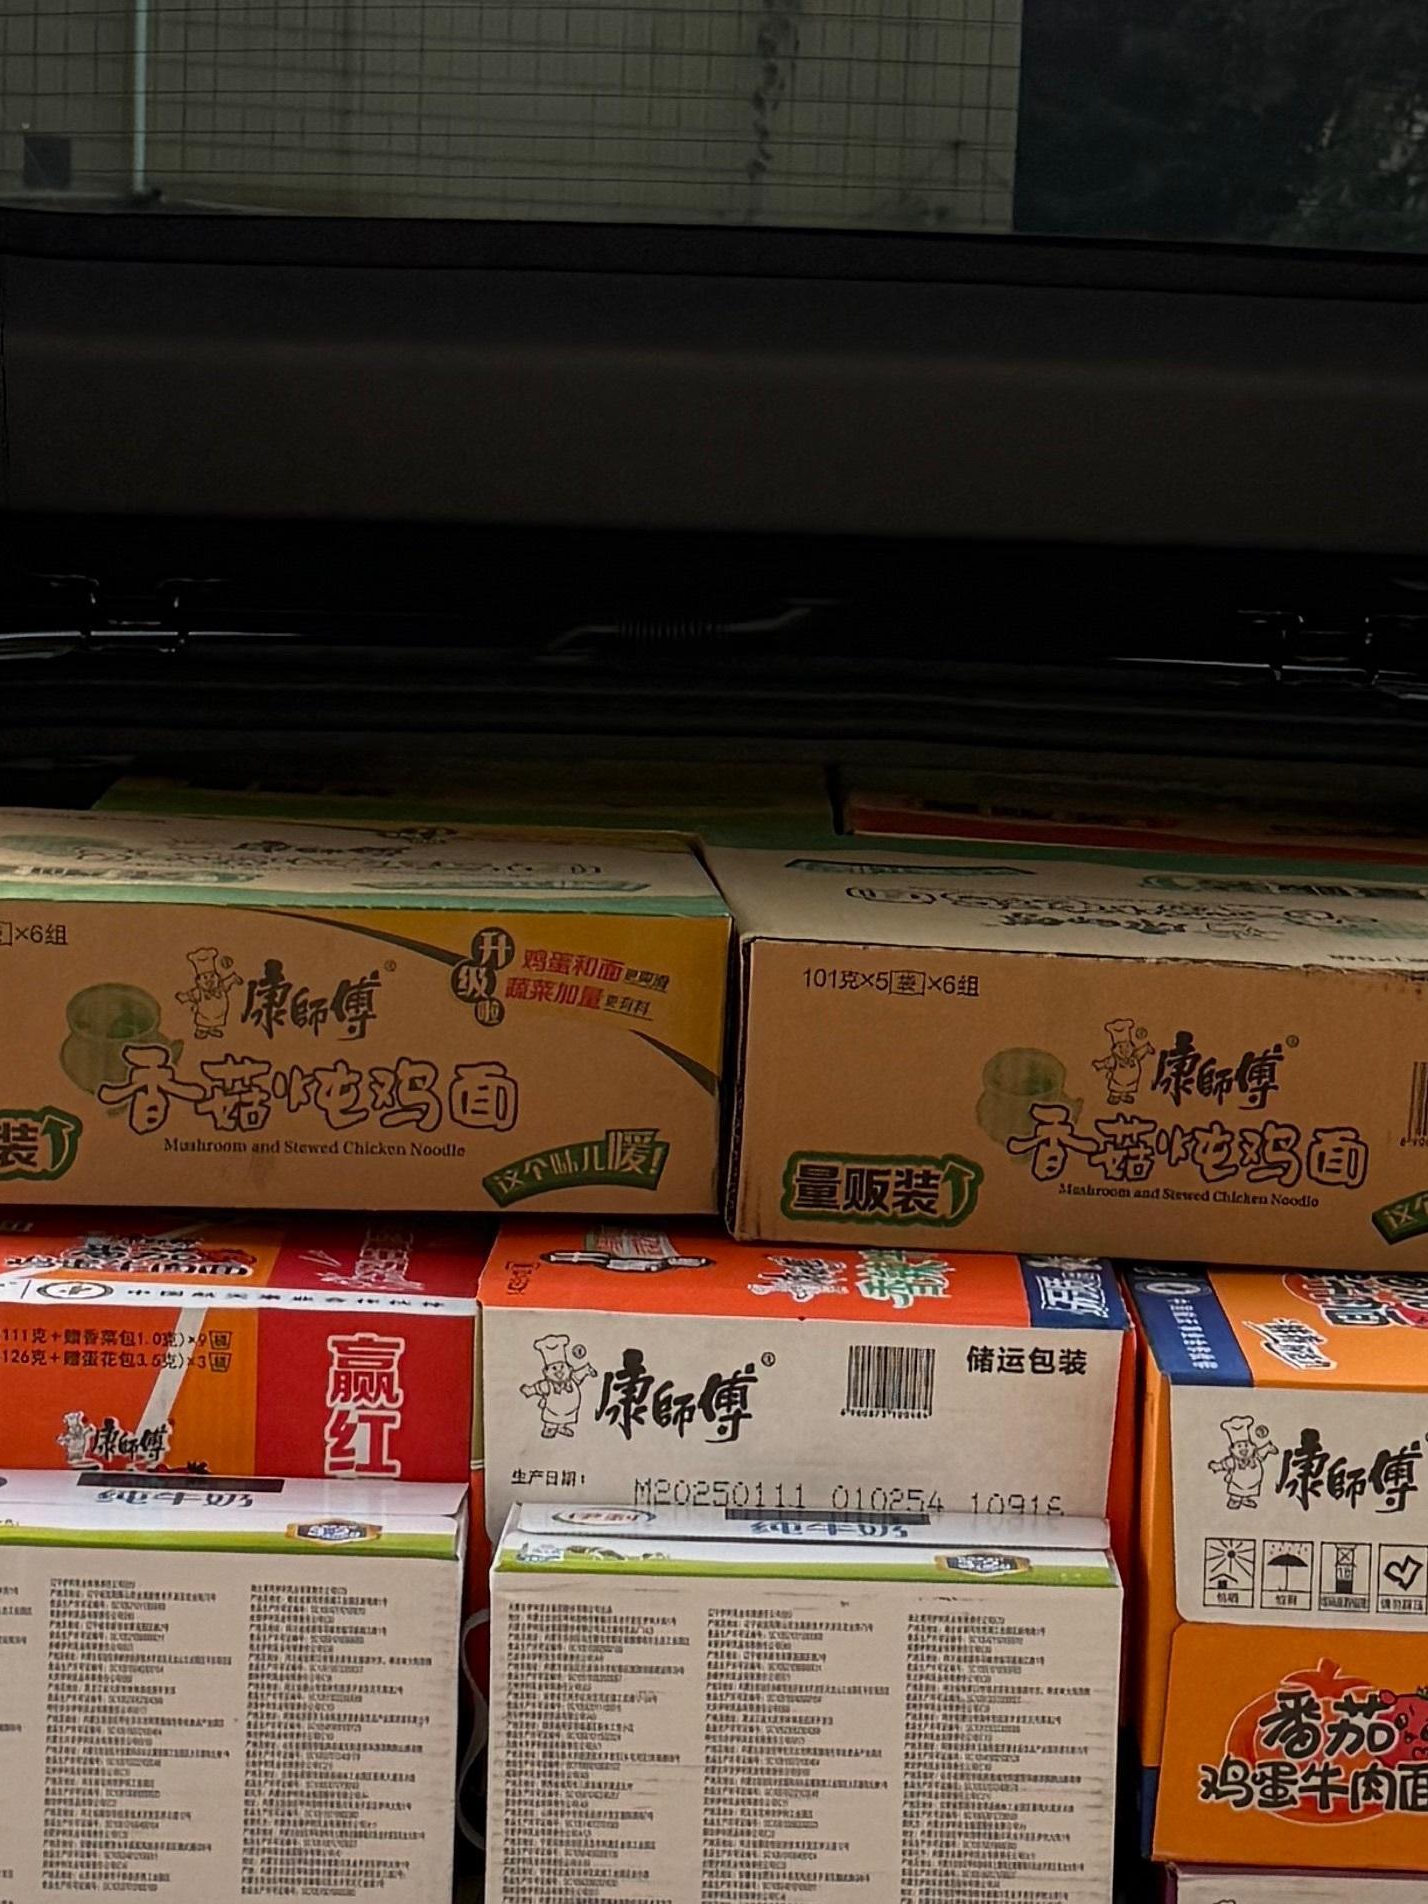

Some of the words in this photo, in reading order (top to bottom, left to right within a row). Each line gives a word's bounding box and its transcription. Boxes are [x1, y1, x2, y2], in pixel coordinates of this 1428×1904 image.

[96, 1042, 518, 1134] 香菇炖鸡面
[164, 1137, 247, 1154] Mushroom
[252, 1139, 280, 1155] and
[284, 1140, 339, 1156] Stewed
[342, 1140, 406, 1157] Chicken
[410, 1142, 465, 1158] Noodle
[1007, 1103, 1367, 1189] 香菇炖鸡面
[793, 1162, 941, 1216] 量贩装
[1059, 1181, 1129, 1199] Mushroom
[1134, 1186, 1159, 1201] and
[1161, 1187, 1209, 1203] Stewed
[1212, 1188, 1268, 1205] Chicken
[966, 1345, 1087, 1375] 储运包装
[635, 1478, 805, 1510] M20250111
[831, 1484, 945, 1515] 010254
[1259, 1688, 1399, 1759] 番茄
